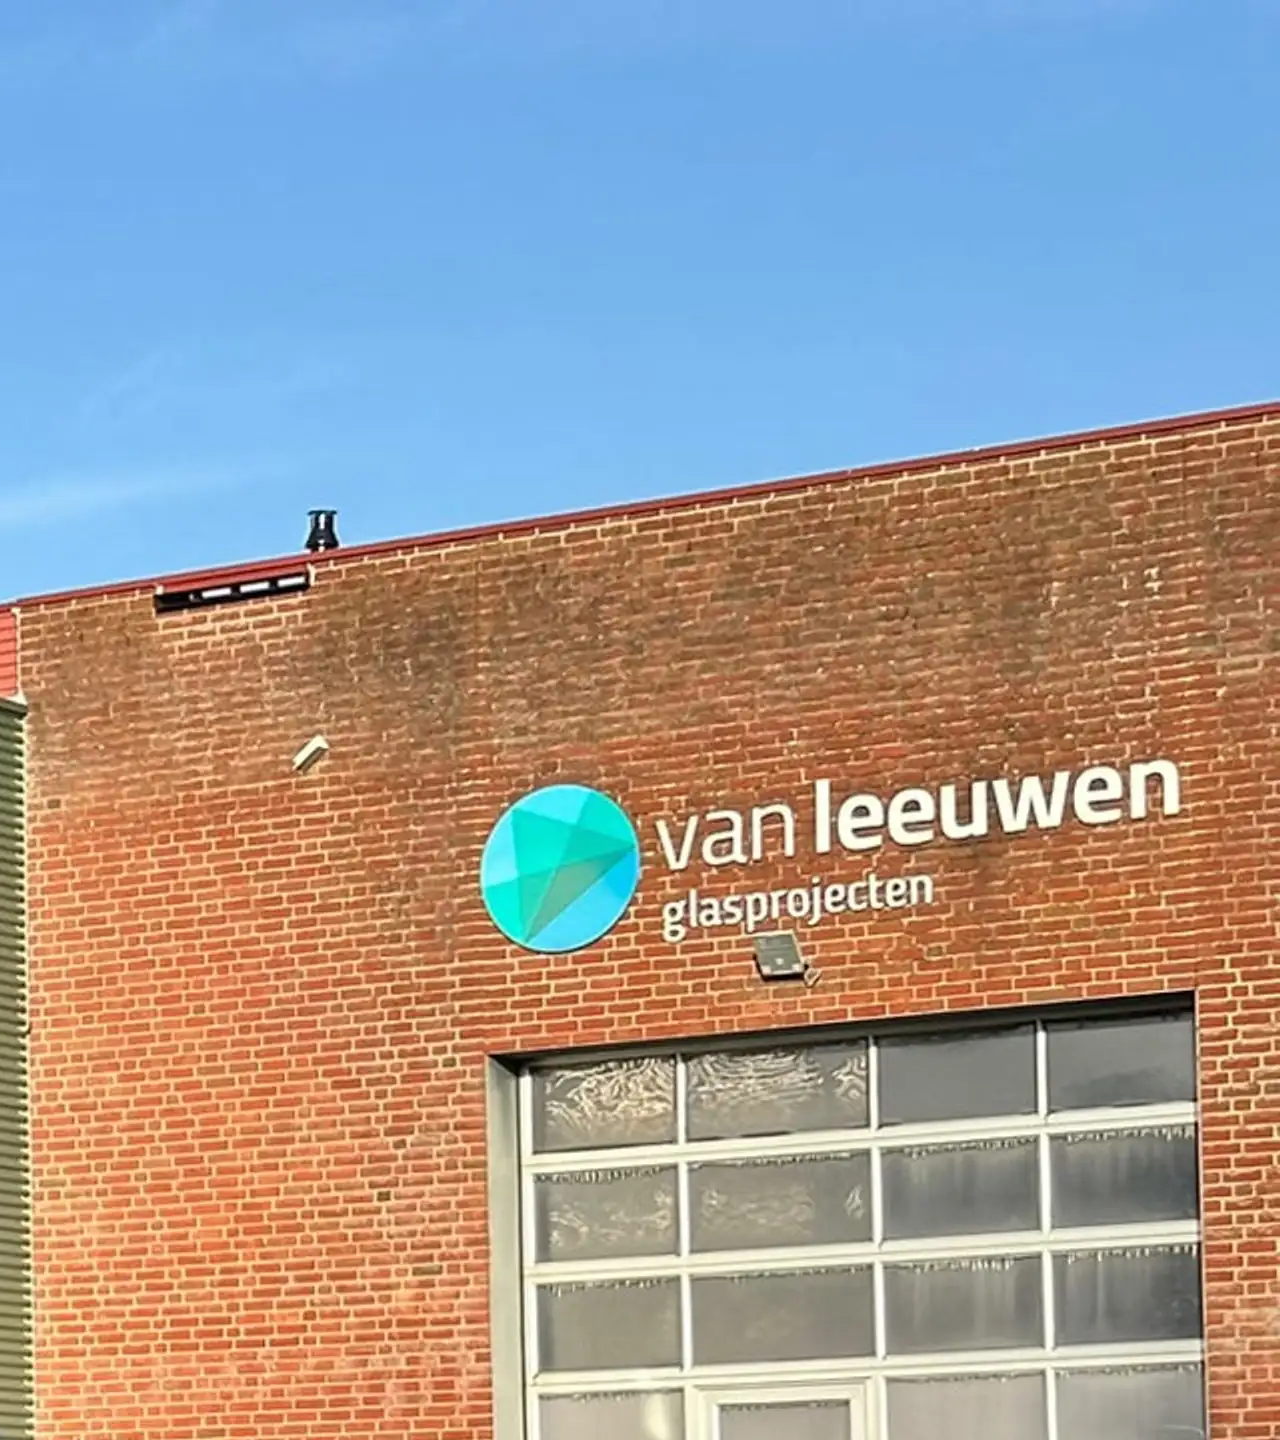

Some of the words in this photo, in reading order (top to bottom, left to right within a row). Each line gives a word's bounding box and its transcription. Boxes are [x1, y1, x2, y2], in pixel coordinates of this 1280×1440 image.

[655, 802, 795, 871] van
[814, 758, 1182, 854] leeuwen
[661, 874, 934, 943] glasprojecten
